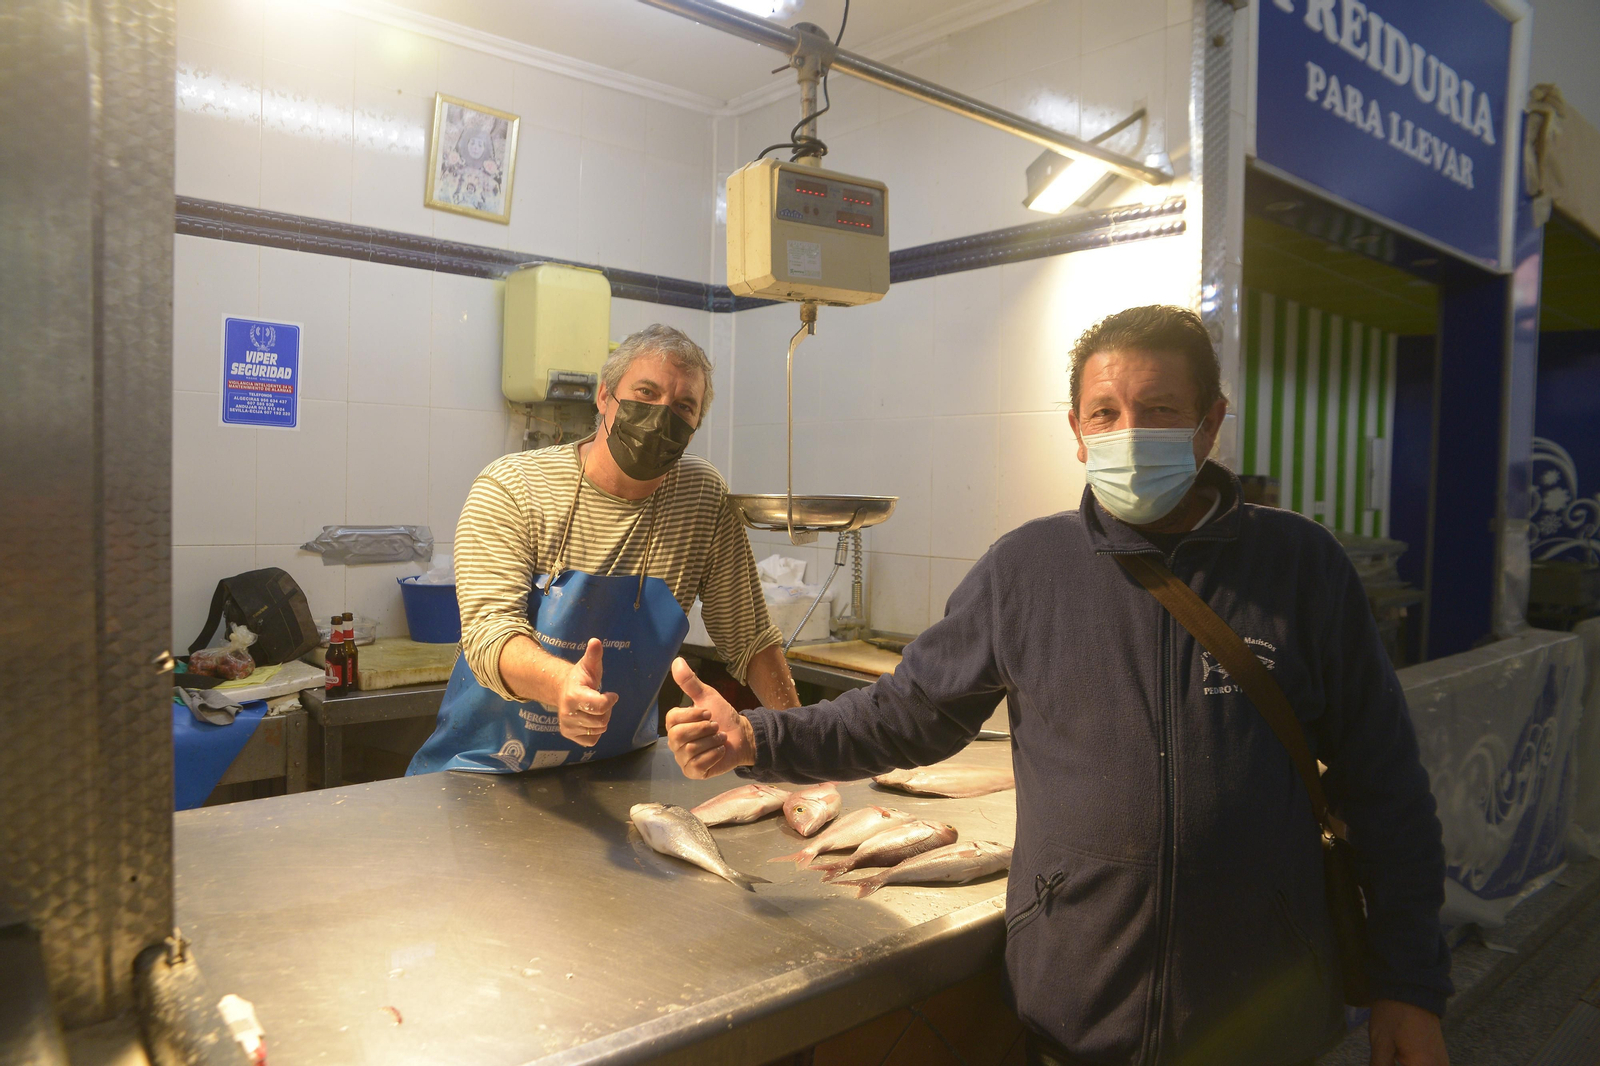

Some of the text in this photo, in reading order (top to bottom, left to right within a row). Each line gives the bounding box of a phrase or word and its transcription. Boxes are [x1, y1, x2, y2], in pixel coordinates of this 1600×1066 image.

[1272, 0, 1496, 145] REIDURIA
[1305, 60, 1474, 189] PARA LLEVAR
[245, 350, 278, 365] VIPER
[230, 362, 292, 379] SEGURIDAD
[577, 642, 587, 651] de
[602, 638, 631, 651] Europa
[1243, 636, 1277, 652] Mariscos
[1203, 685, 1232, 696] PEDRO
[518, 707, 560, 726] MERCAD
[524, 720, 560, 733] INGENIER
